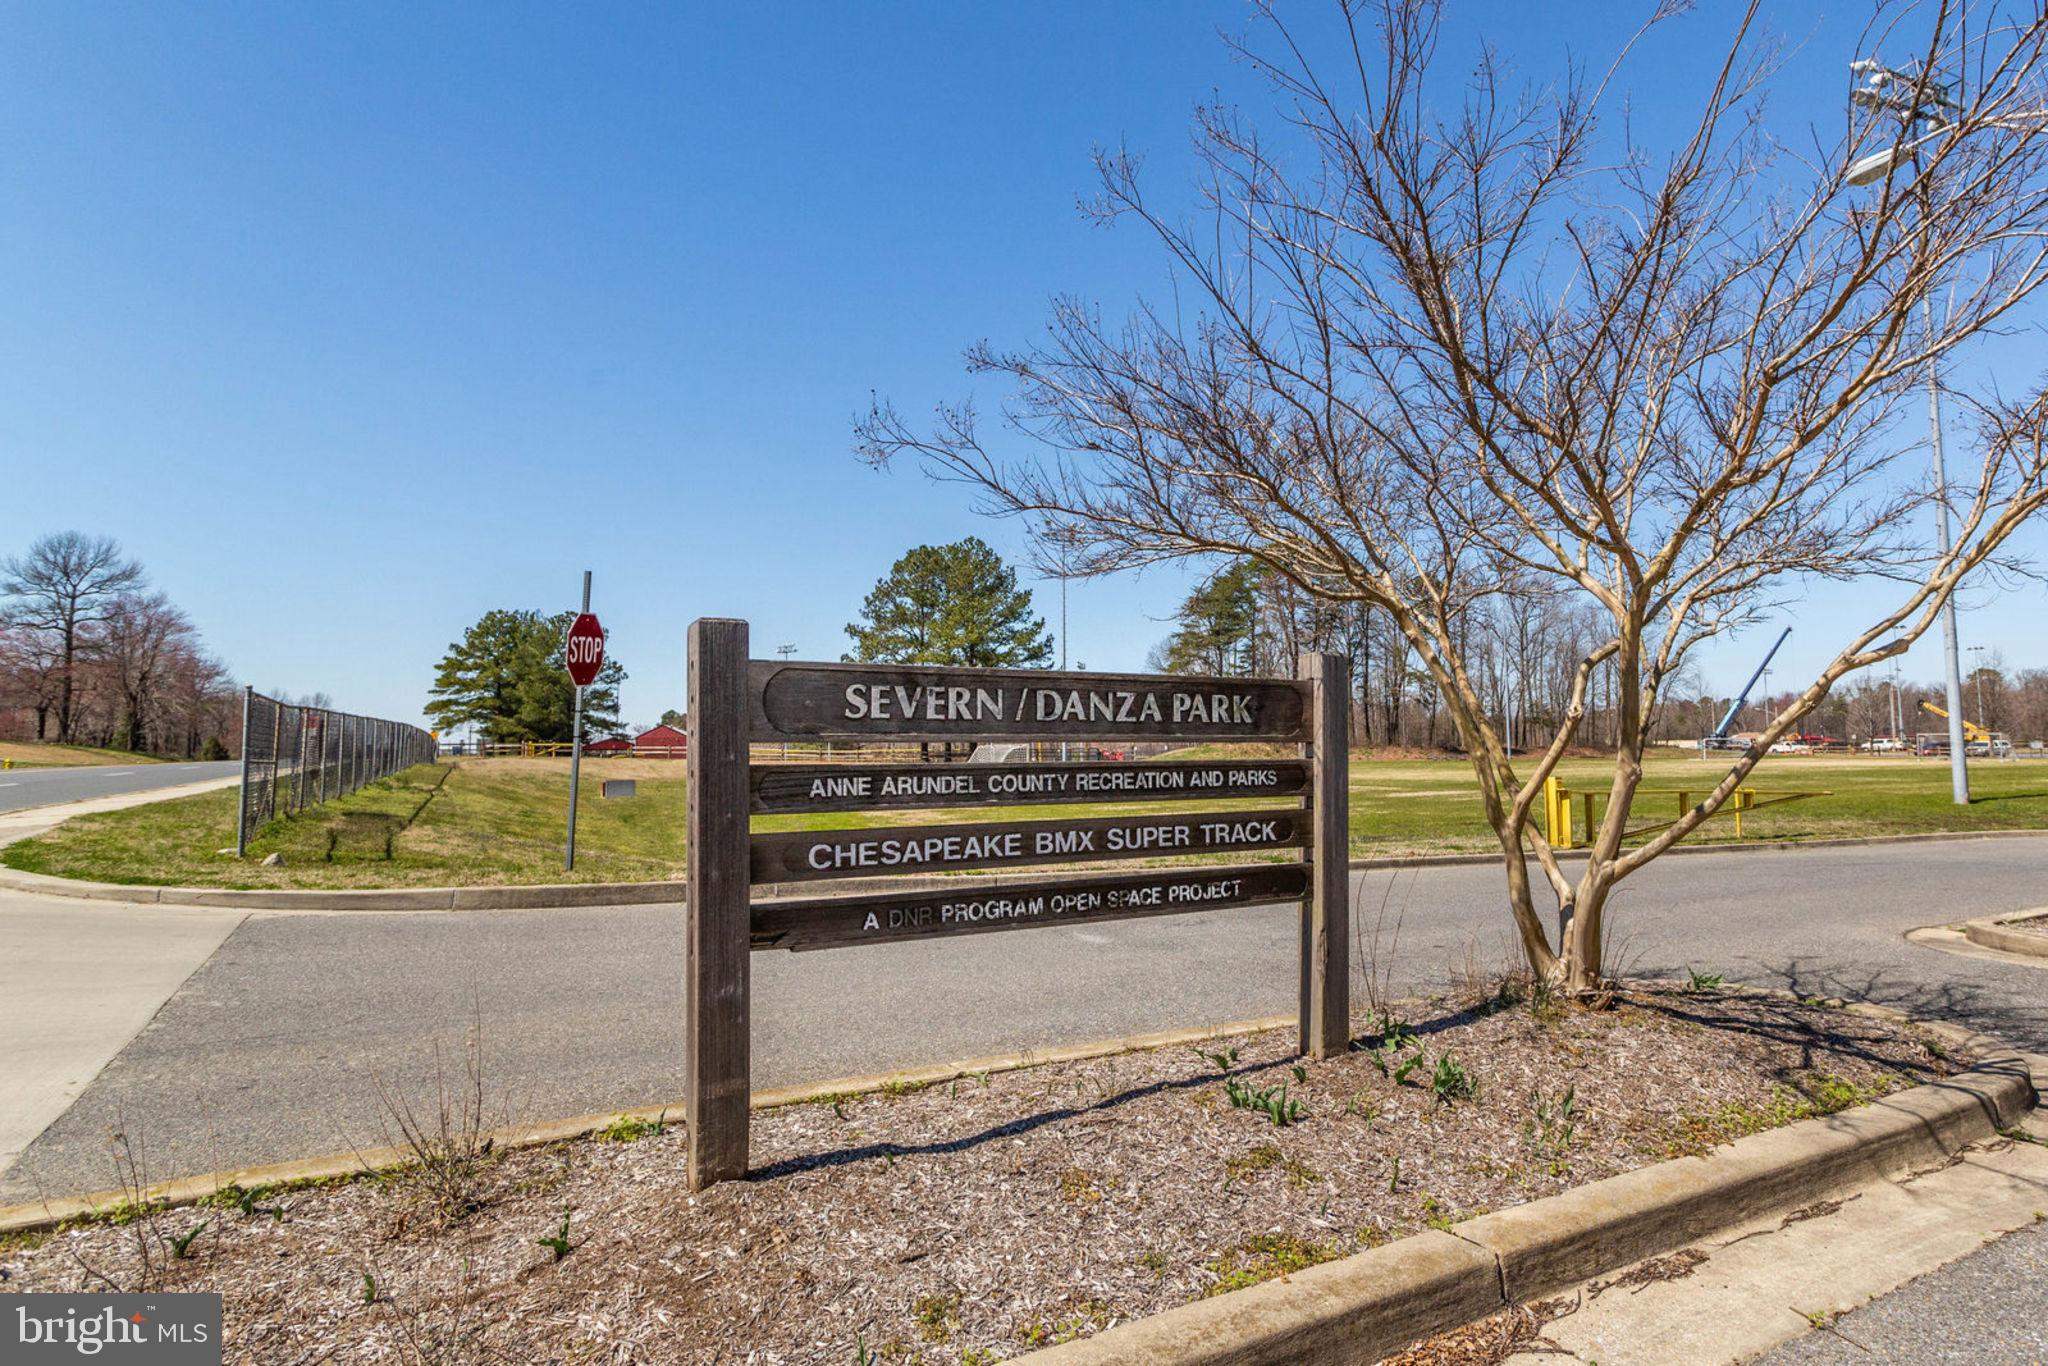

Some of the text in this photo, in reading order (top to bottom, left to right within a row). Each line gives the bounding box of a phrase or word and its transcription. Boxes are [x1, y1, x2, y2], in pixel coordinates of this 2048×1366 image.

[569, 636, 602, 663] STOP
[844, 684, 1003, 720] SEVERN
[1036, 689, 1163, 722] DANZA
[1172, 692, 1253, 723] PARK
[810, 769, 1277, 798] ANNE ARUNDEL COUNTY RECREATION AND PARKS
[808, 821, 1277, 869] CHESAPEAKE BMX SUPER TRACK
[863, 880, 1241, 931] A DNR PROGRAM OPEN SPACE PROJECT
